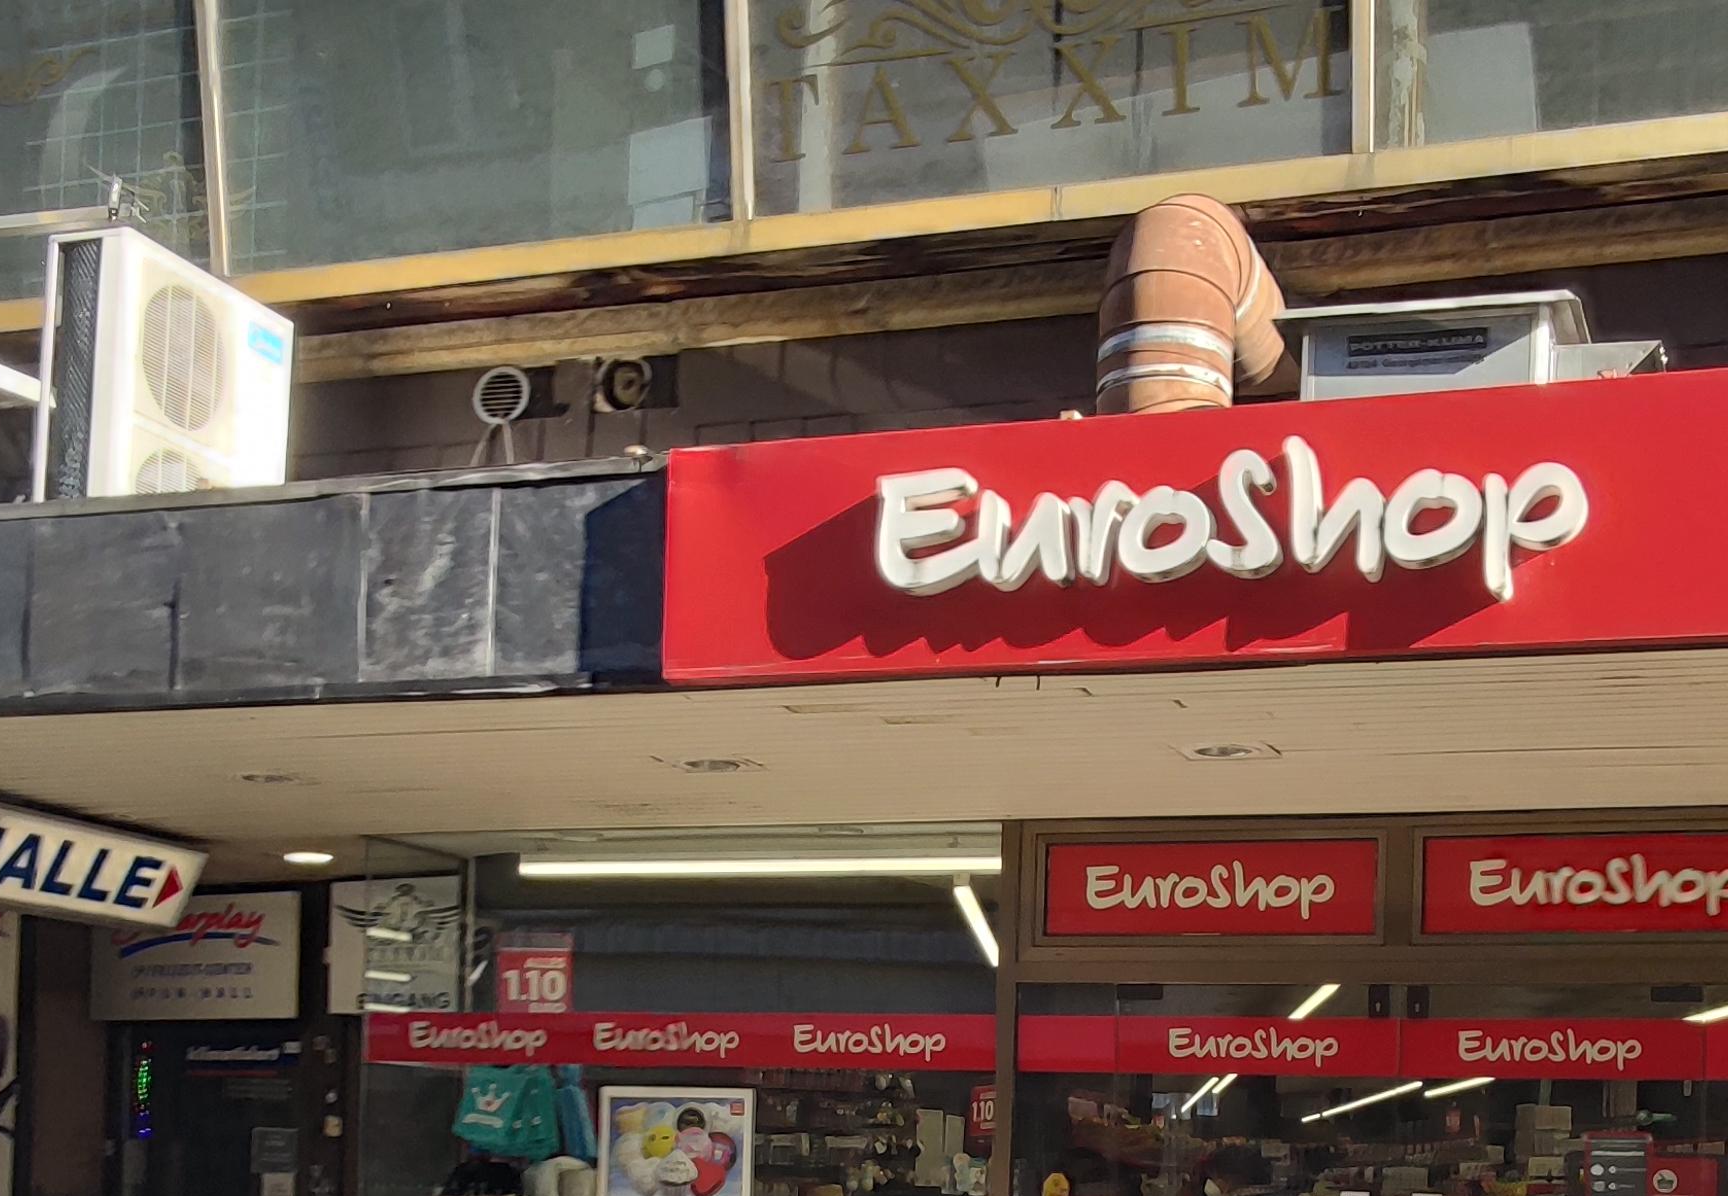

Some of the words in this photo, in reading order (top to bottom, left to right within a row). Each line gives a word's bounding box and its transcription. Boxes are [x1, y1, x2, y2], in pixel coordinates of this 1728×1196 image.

[769, 5, 1344, 163] TAXXIM
[876, 436, 1589, 602] EuroShop
[1085, 860, 1336, 920] EuroShop
[503, 970, 567, 1001] 1.10
[408, 1021, 548, 1057] EuroShop
[592, 1022, 740, 1058] EuroShop
[792, 1023, 947, 1062] EuroShop
[1167, 1026, 1339, 1067] EuroShop
[1457, 1028, 1643, 1071] EuroShop
